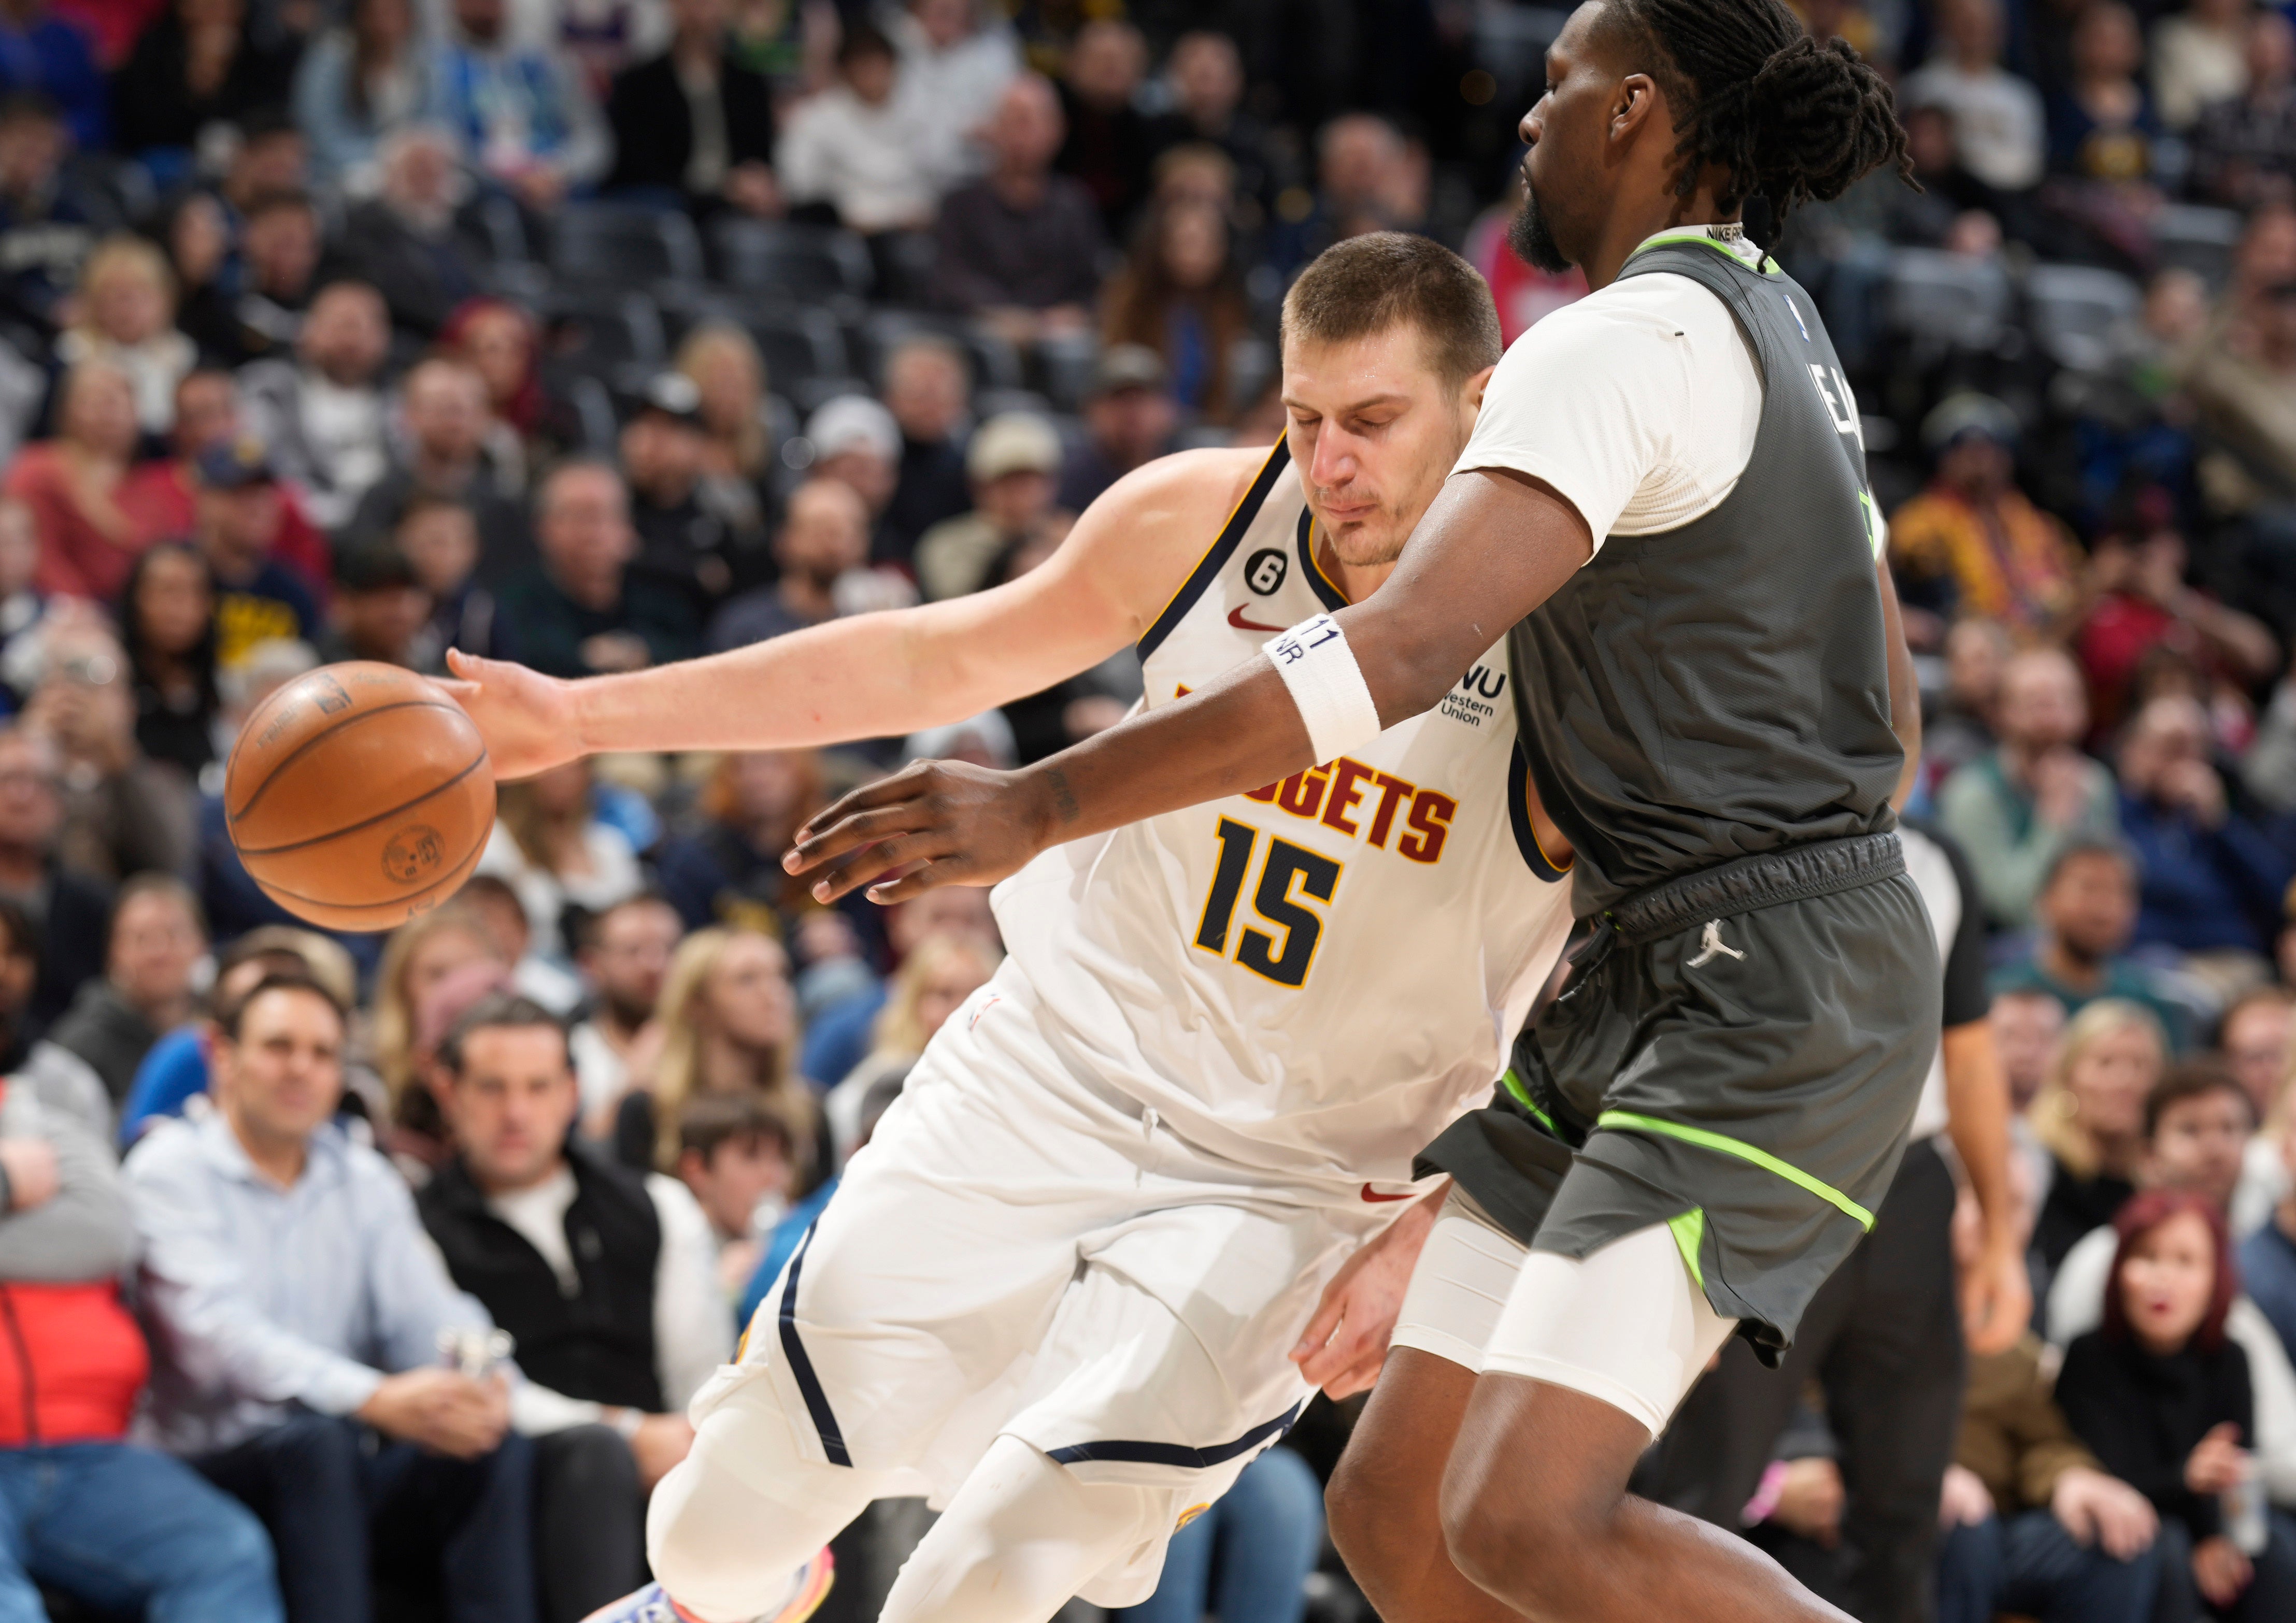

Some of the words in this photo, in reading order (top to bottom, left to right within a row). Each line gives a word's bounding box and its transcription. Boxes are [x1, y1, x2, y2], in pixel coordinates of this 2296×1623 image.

[1706, 227, 1731, 242] NIKE
[1251, 554, 1284, 591] 6
[1442, 702, 1480, 726] Union
[1192, 813, 1345, 990] 15
